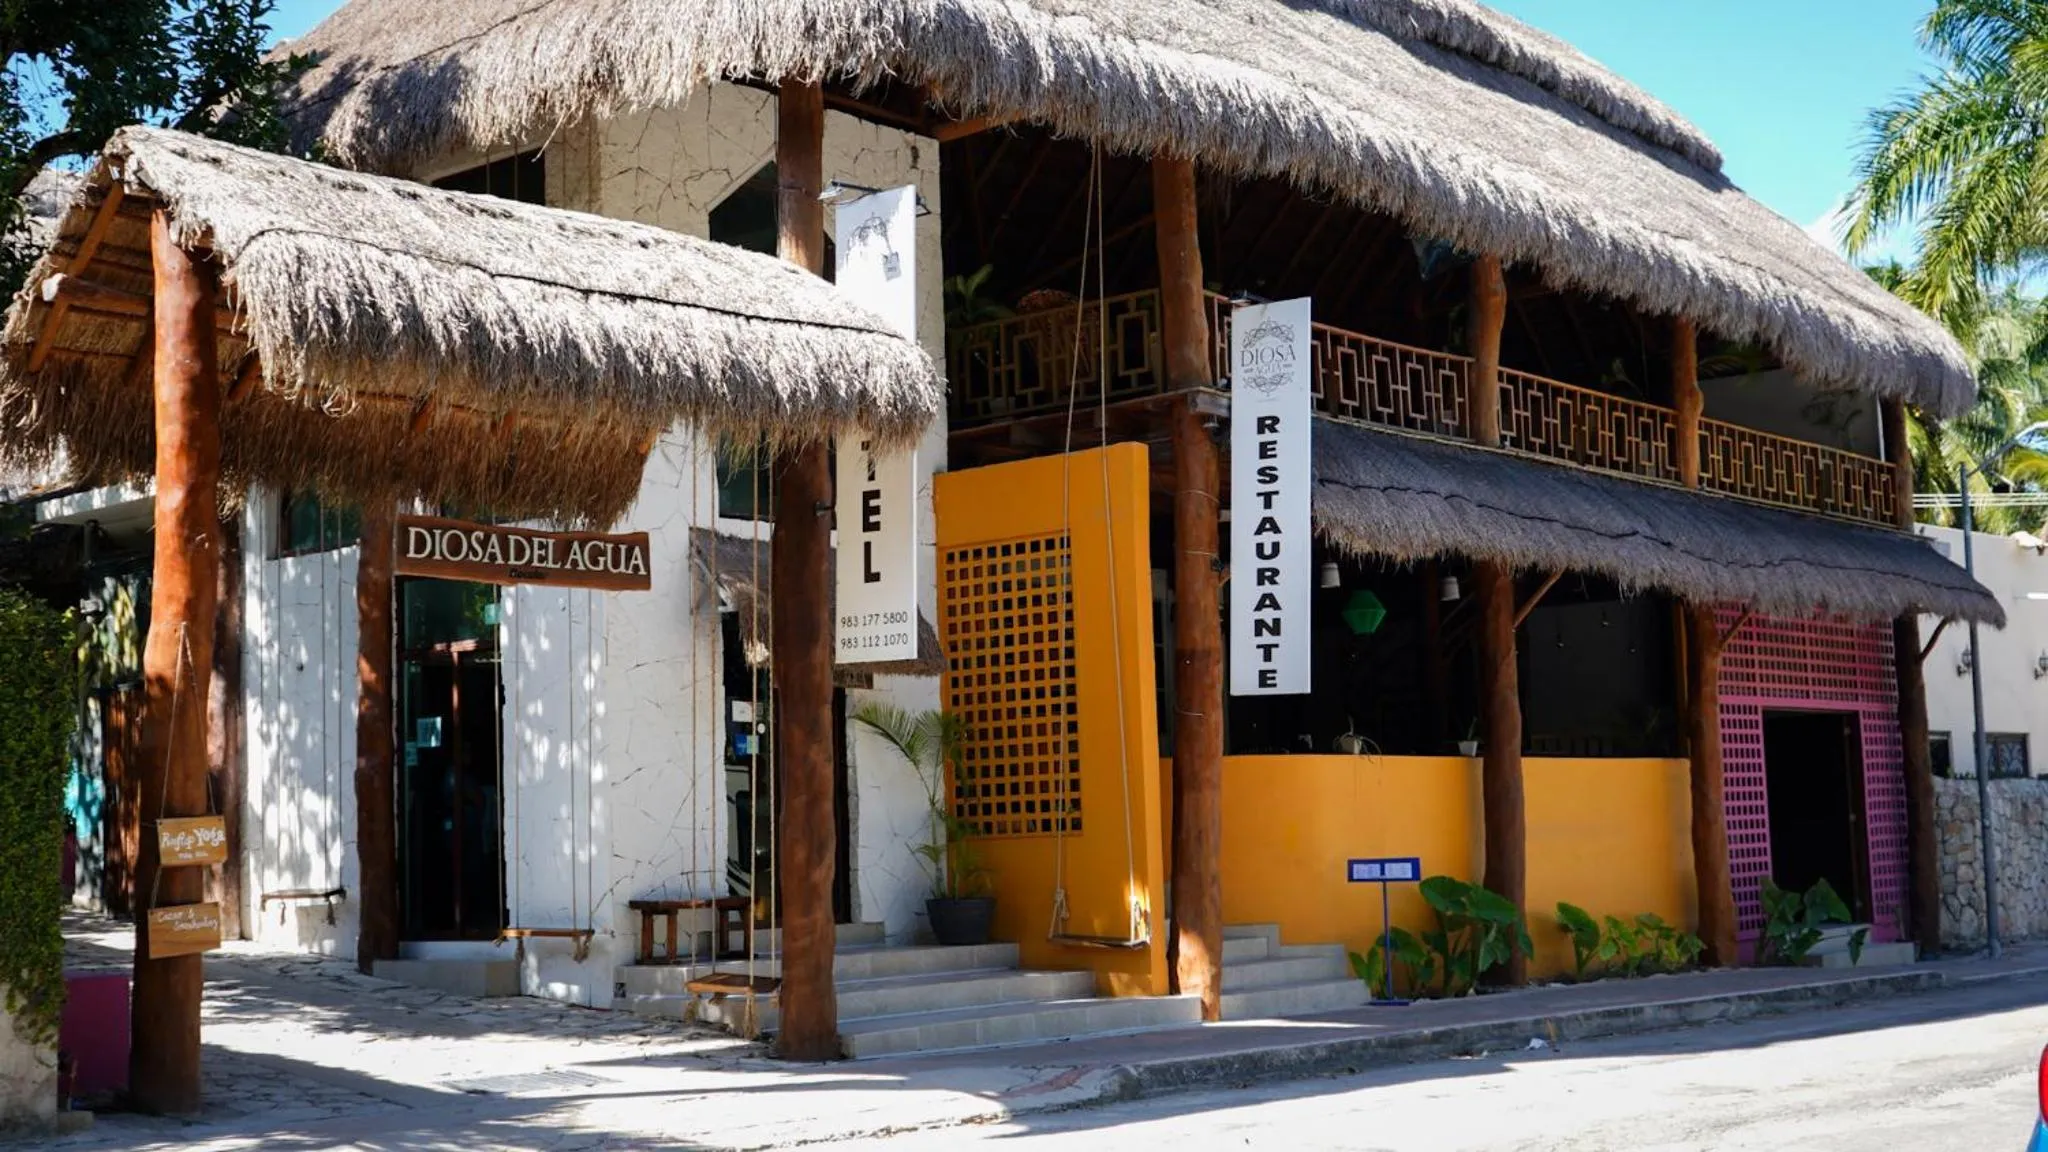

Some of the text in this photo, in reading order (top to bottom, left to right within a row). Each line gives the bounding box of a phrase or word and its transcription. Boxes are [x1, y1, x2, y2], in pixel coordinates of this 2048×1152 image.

[1240, 344, 1296, 367] DIOSA
[406, 526, 647, 575] DIOSA DEL AGUA
[1253, 415, 1282, 688] RESTAURANTE
[841, 611, 908, 628] 983 177 5800
[841, 633, 908, 649] 983 112 1070
[193, 827, 225, 847] Yoga
